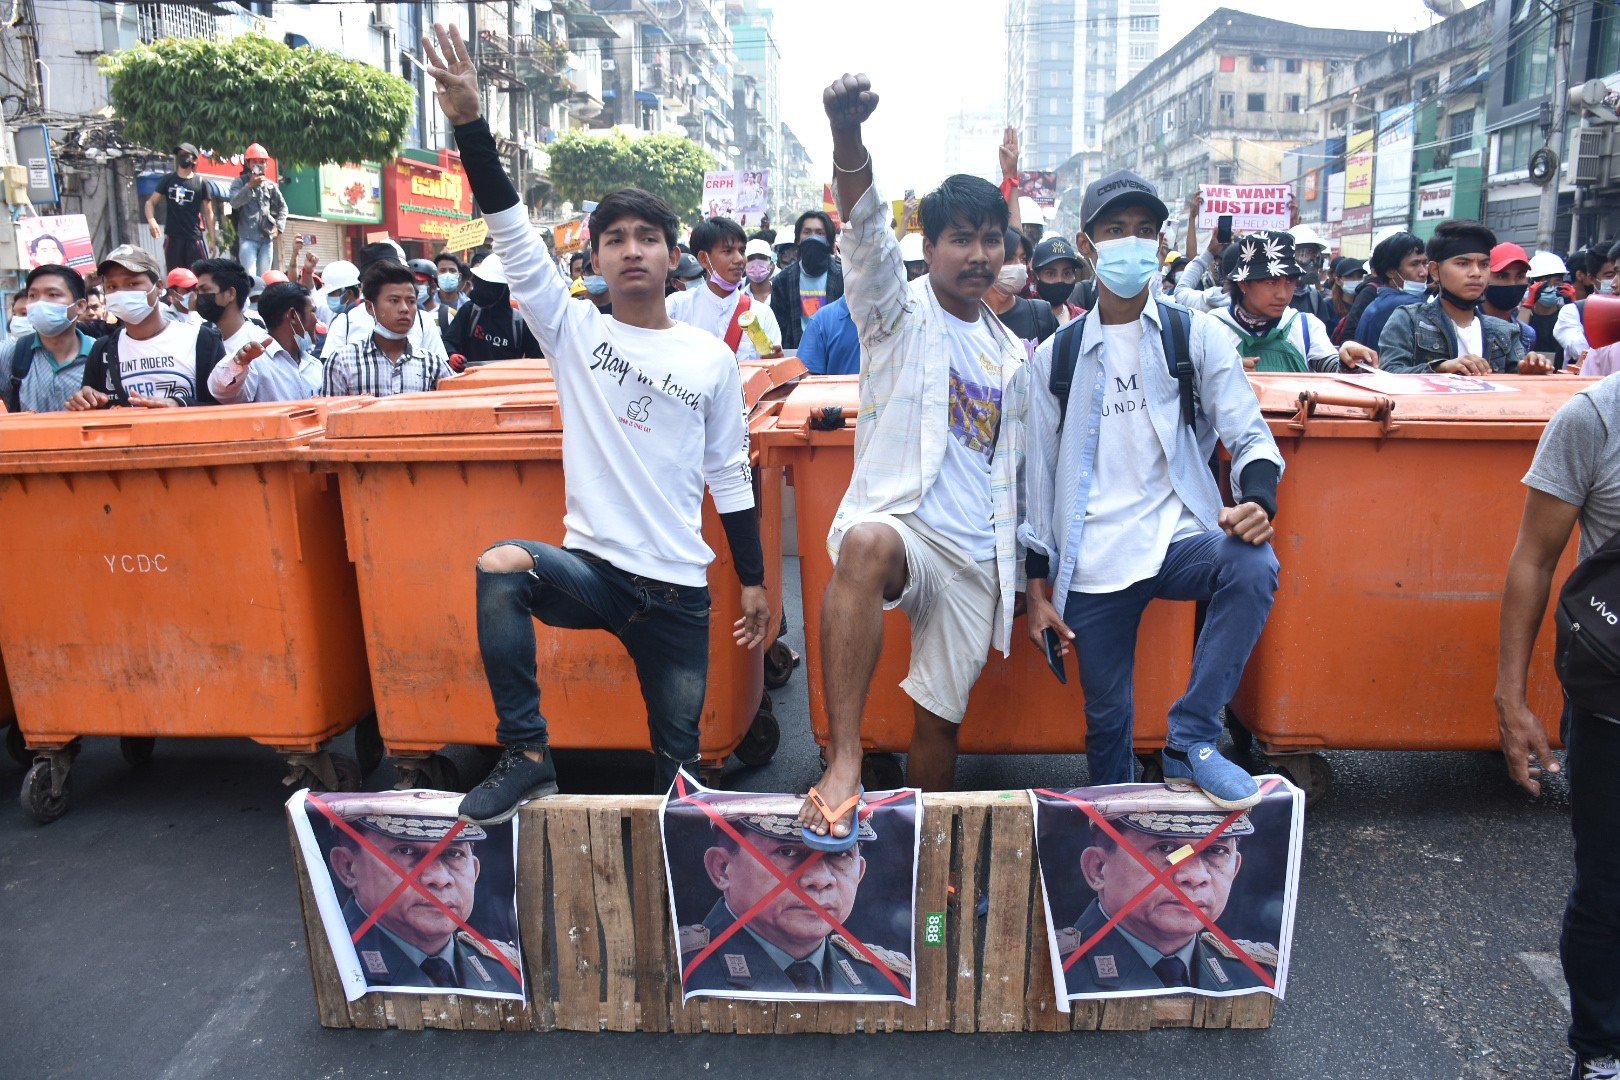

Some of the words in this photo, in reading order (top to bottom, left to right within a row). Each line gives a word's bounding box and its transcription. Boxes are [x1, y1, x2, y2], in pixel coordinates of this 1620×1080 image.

[705, 179, 734, 189] CRPH
[1206, 187, 1231, 198] WE
[1235, 188, 1286, 199] WANT
[1205, 200, 1285, 215] JUSTICE
[459, 220, 483, 234] STOP
[1204, 218, 1240, 228] PLE
[1244, 218, 1269, 228] HELP
[1271, 219, 1285, 228] US
[140, 356, 175, 370] RIDERS
[590, 341, 633, 387] Stay
[637, 368, 653, 386] in
[662, 373, 702, 411] touch
[1114, 373, 1139, 393] M
[103, 553, 168, 574] YCDC
[1590, 596, 1619, 625] vivo
[928, 915, 940, 943] 888
